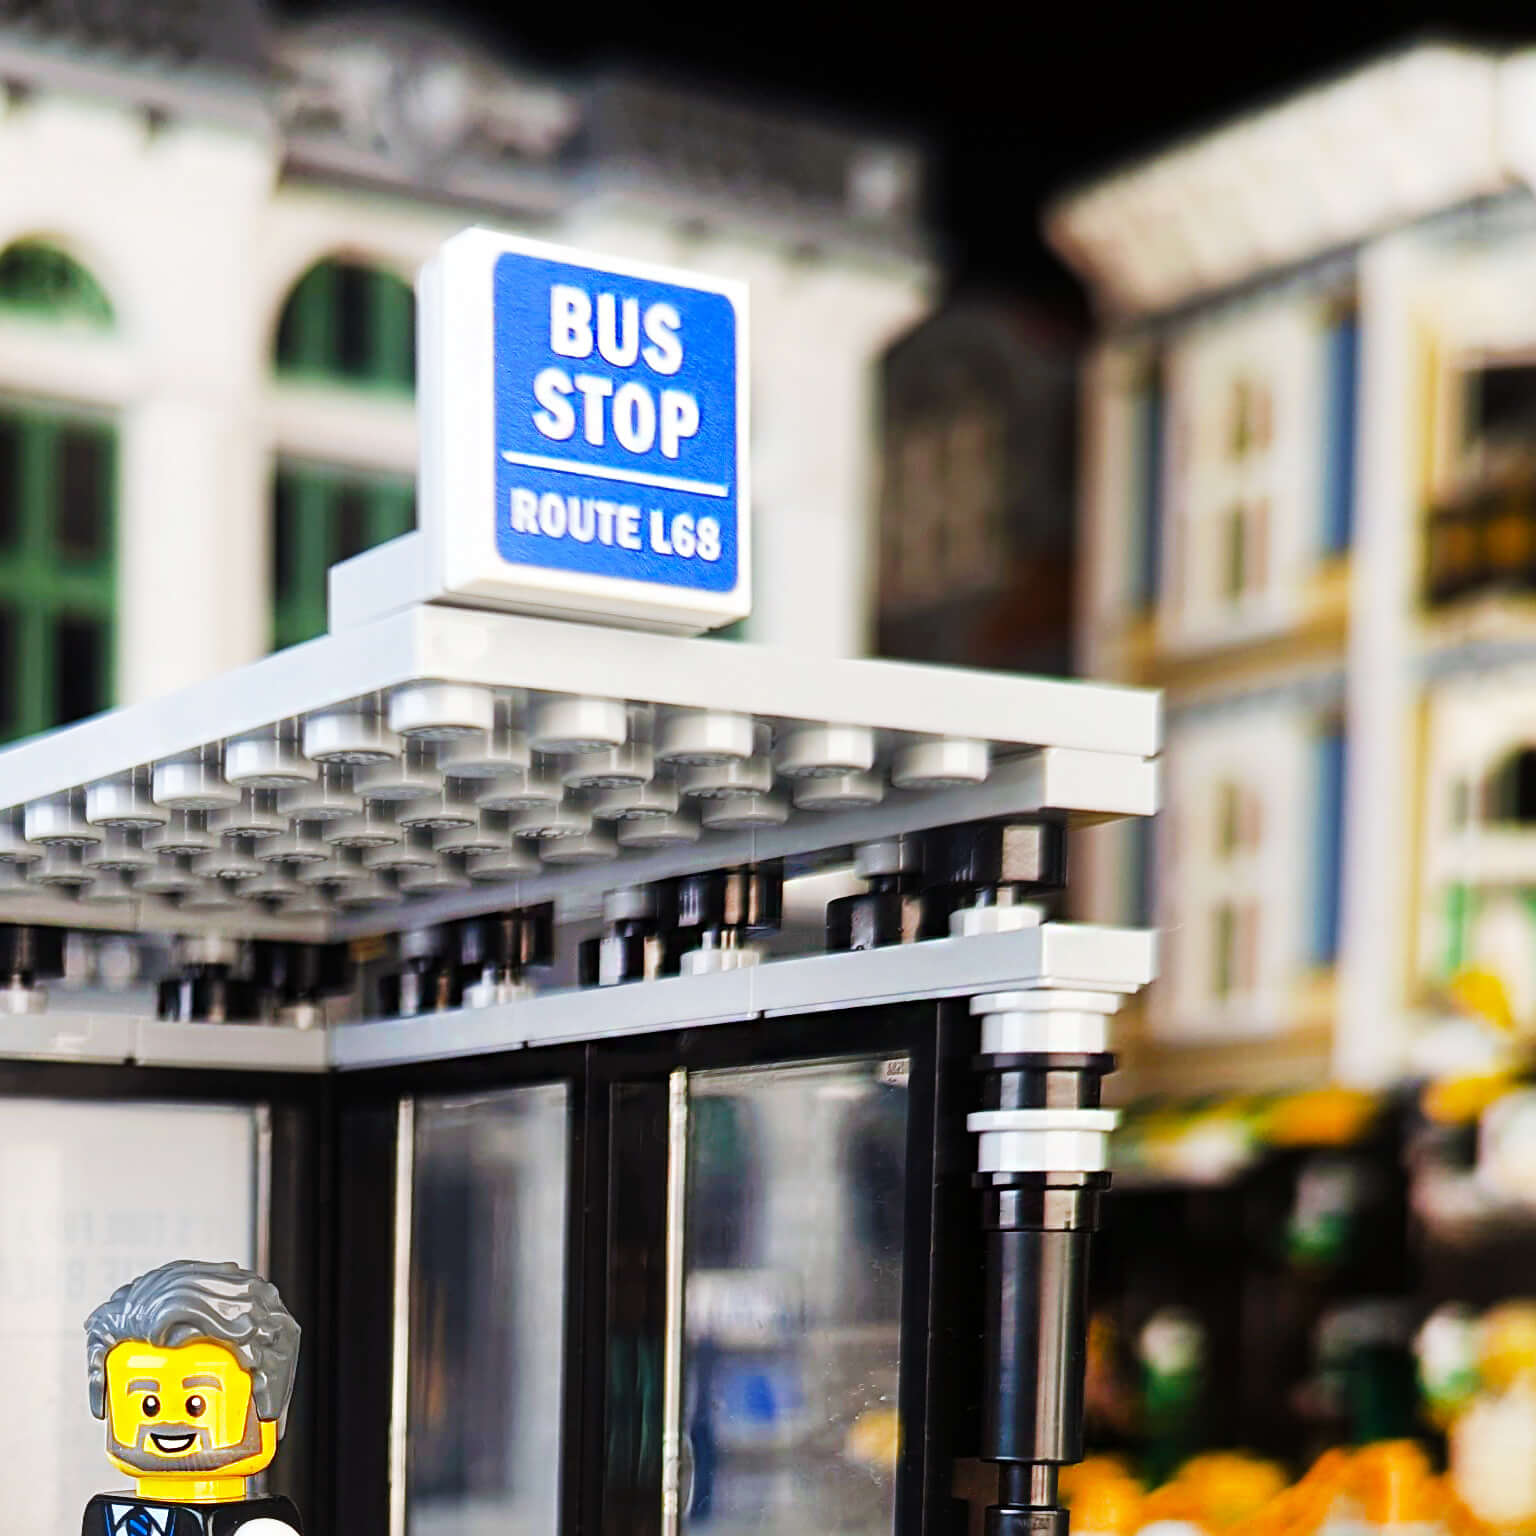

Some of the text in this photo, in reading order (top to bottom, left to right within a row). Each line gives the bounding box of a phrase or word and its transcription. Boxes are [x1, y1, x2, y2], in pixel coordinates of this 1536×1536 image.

[549, 283, 684, 376] BUS
[531, 366, 701, 459] STOP
[509, 486, 723, 562] ROUTE L68
